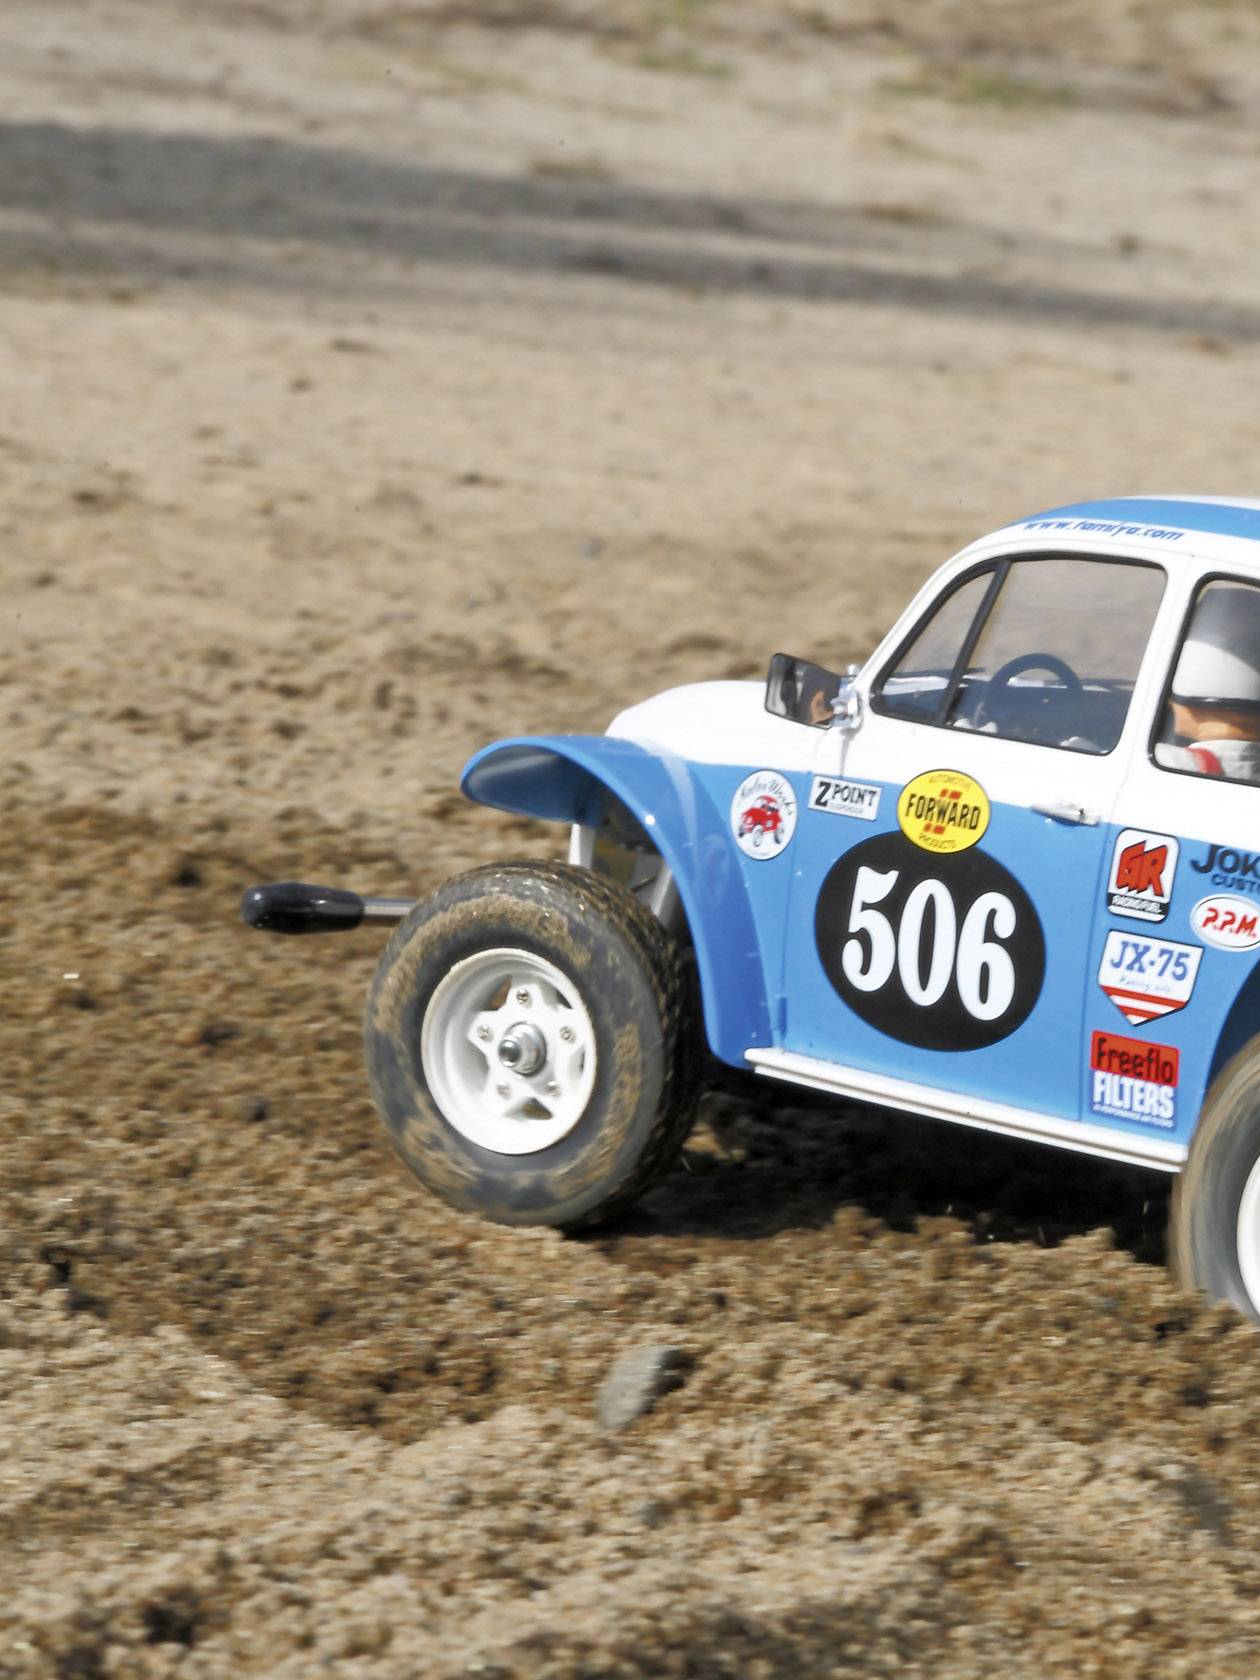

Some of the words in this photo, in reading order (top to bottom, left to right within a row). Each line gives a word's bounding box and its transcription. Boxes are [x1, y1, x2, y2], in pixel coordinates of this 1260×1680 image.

[1025, 518, 1185, 541] www.tamiya.com
[815, 781, 831, 807] Z
[831, 783, 877, 806] POINT
[905, 792, 981, 831] FORWARD
[842, 865, 1016, 1021] 506
[1110, 940, 1191, 982] JX-75
[1097, 1036, 1174, 1084] Freeflo
[1092, 1069, 1175, 1120] FILTERS
